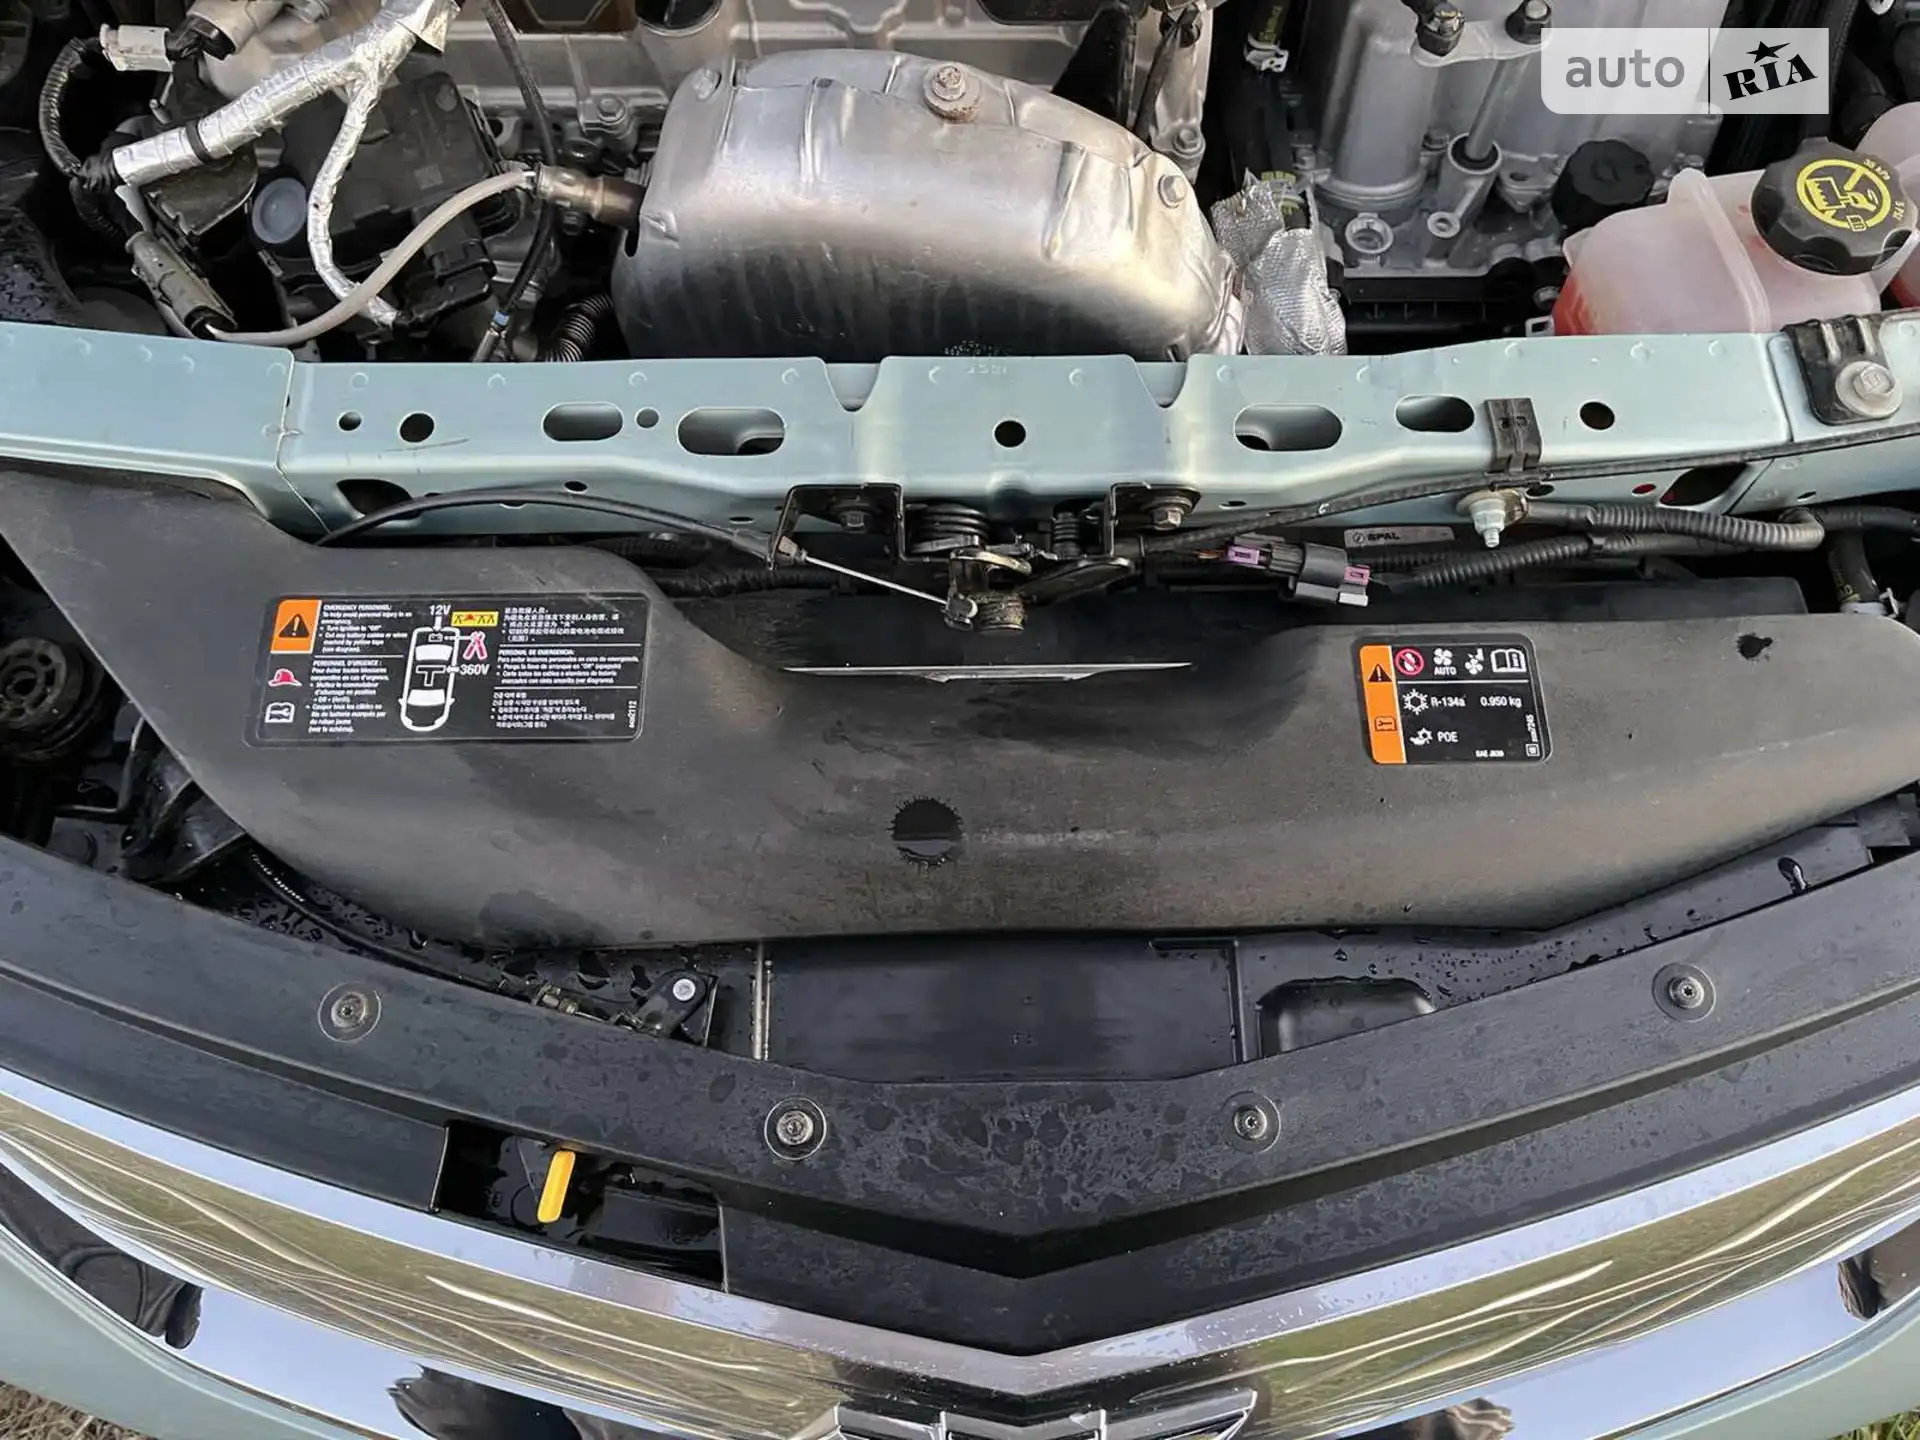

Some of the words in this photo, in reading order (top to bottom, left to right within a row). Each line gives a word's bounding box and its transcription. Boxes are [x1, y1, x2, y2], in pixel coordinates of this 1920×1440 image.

[430, 604, 452, 615] 12V
[460, 664, 490, 675] 360V
[1434, 666, 1457, 676] AUTO
[1431, 697, 1466, 707] R-134a
[1480, 697, 1507, 706] 0.950
[1509, 697, 1522, 708] kg
[1437, 731, 1458, 743] POE
